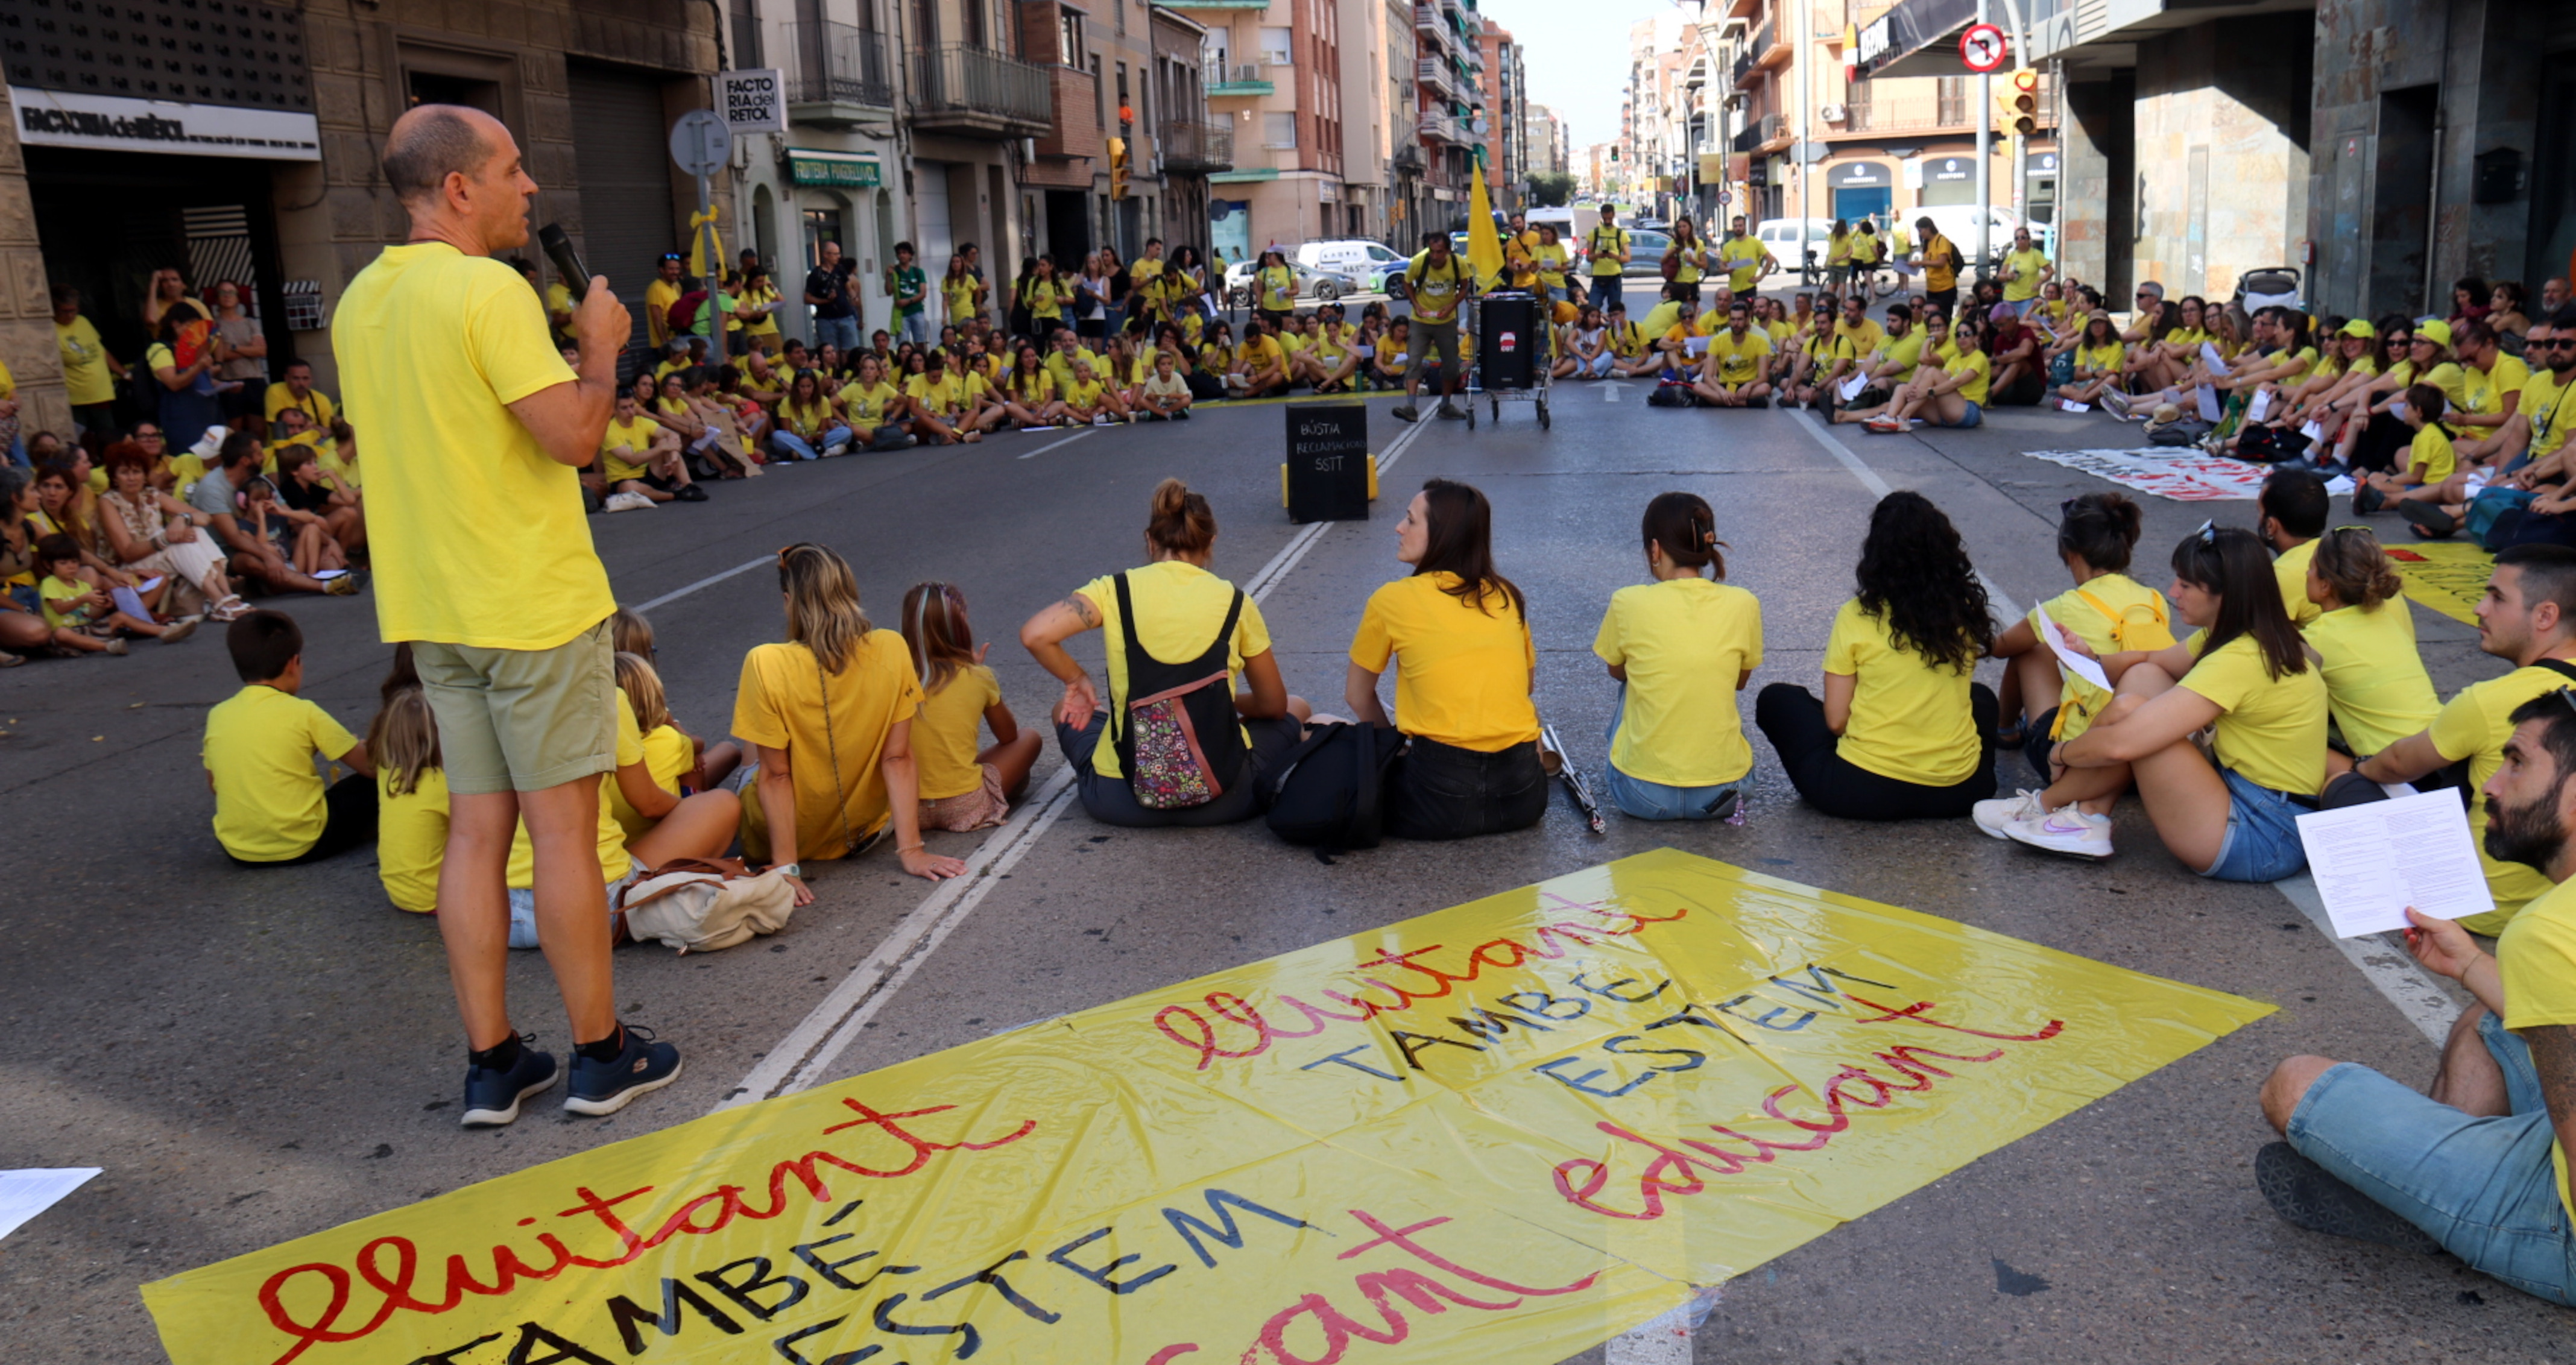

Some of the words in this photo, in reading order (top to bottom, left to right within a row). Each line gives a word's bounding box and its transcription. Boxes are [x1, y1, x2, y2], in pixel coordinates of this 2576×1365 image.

[726, 78, 773, 93] FACTO
[1315, 456, 1345, 471] SSTT
[1532, 963, 1898, 1098] ESTEM
[1553, 993, 2065, 1220] educant
[258, 1097, 1037, 1365] lluitant
